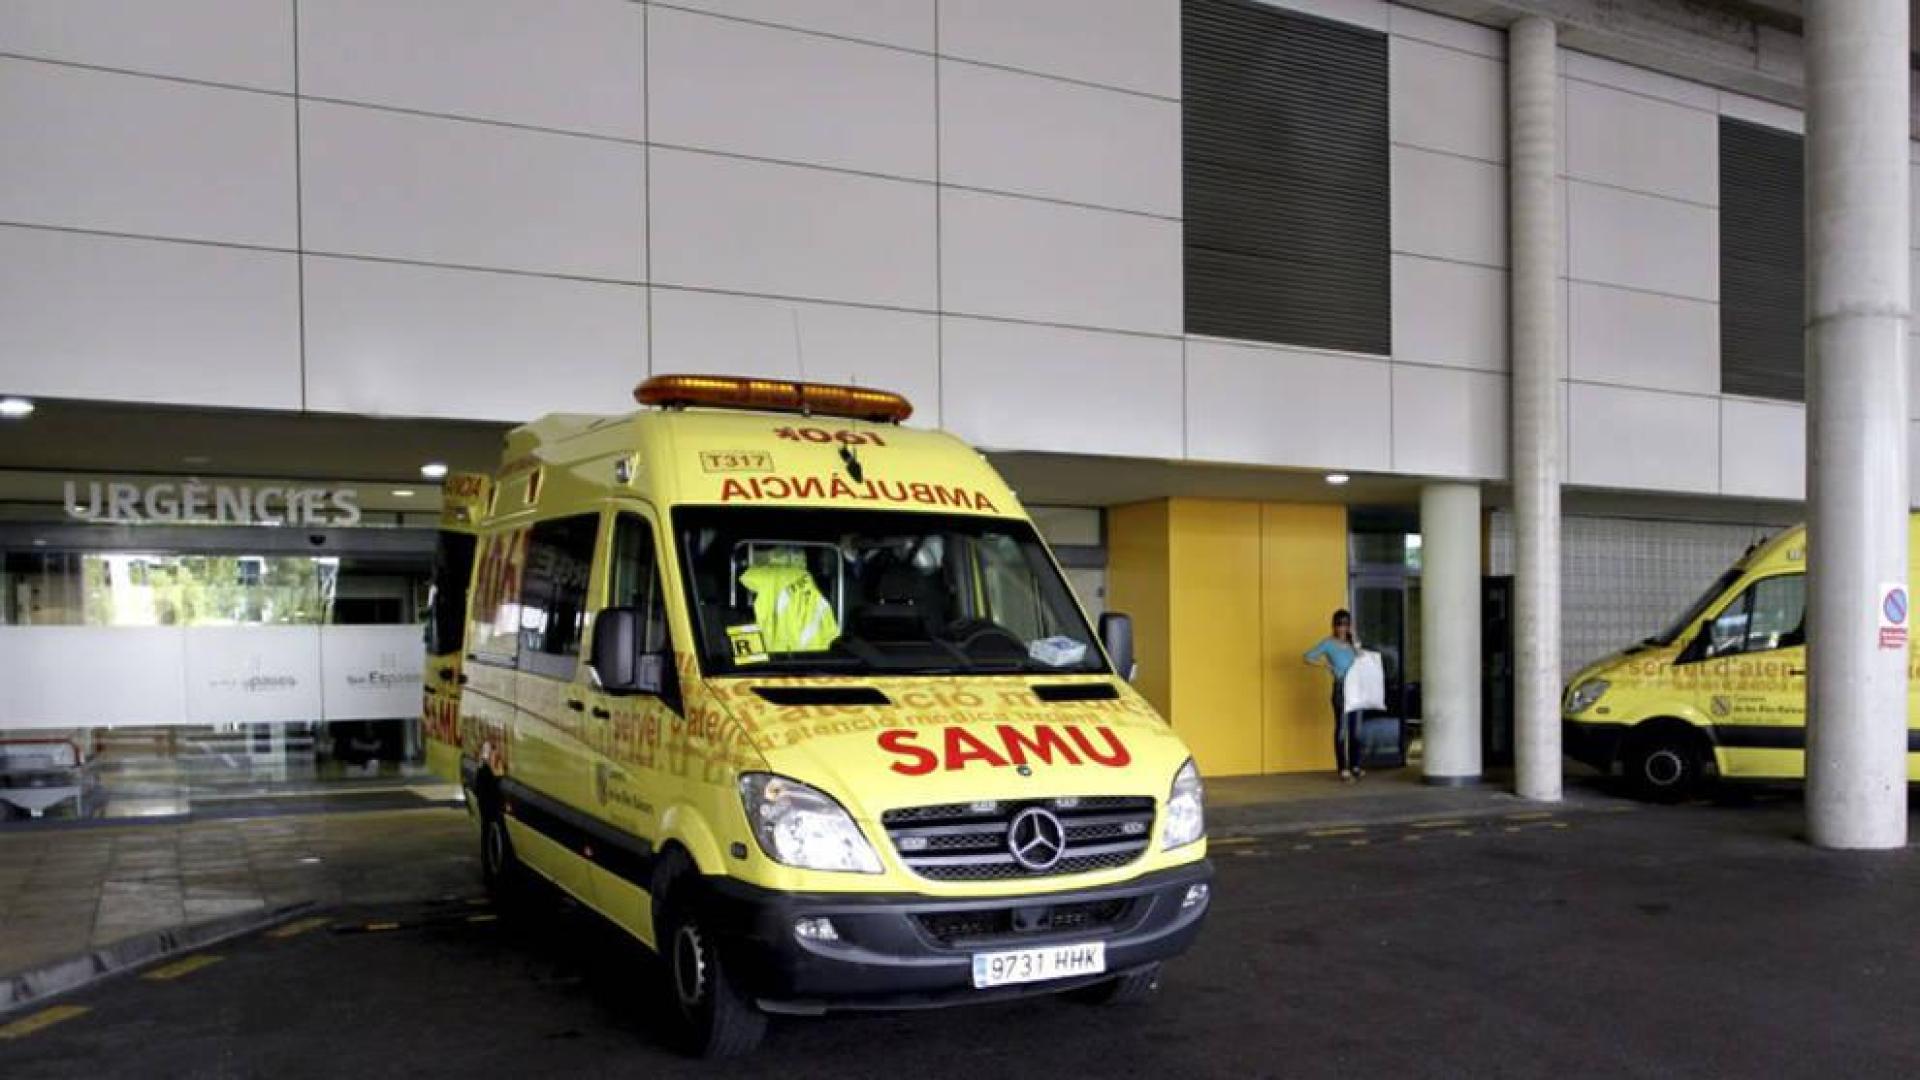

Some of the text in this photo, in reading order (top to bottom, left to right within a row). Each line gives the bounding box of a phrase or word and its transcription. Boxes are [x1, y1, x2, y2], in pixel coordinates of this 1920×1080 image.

[708, 453, 766, 468] T317
[735, 639, 752, 657] R
[877, 724, 1132, 776] SAMU
[992, 946, 1097, 979] 9731 HHK
